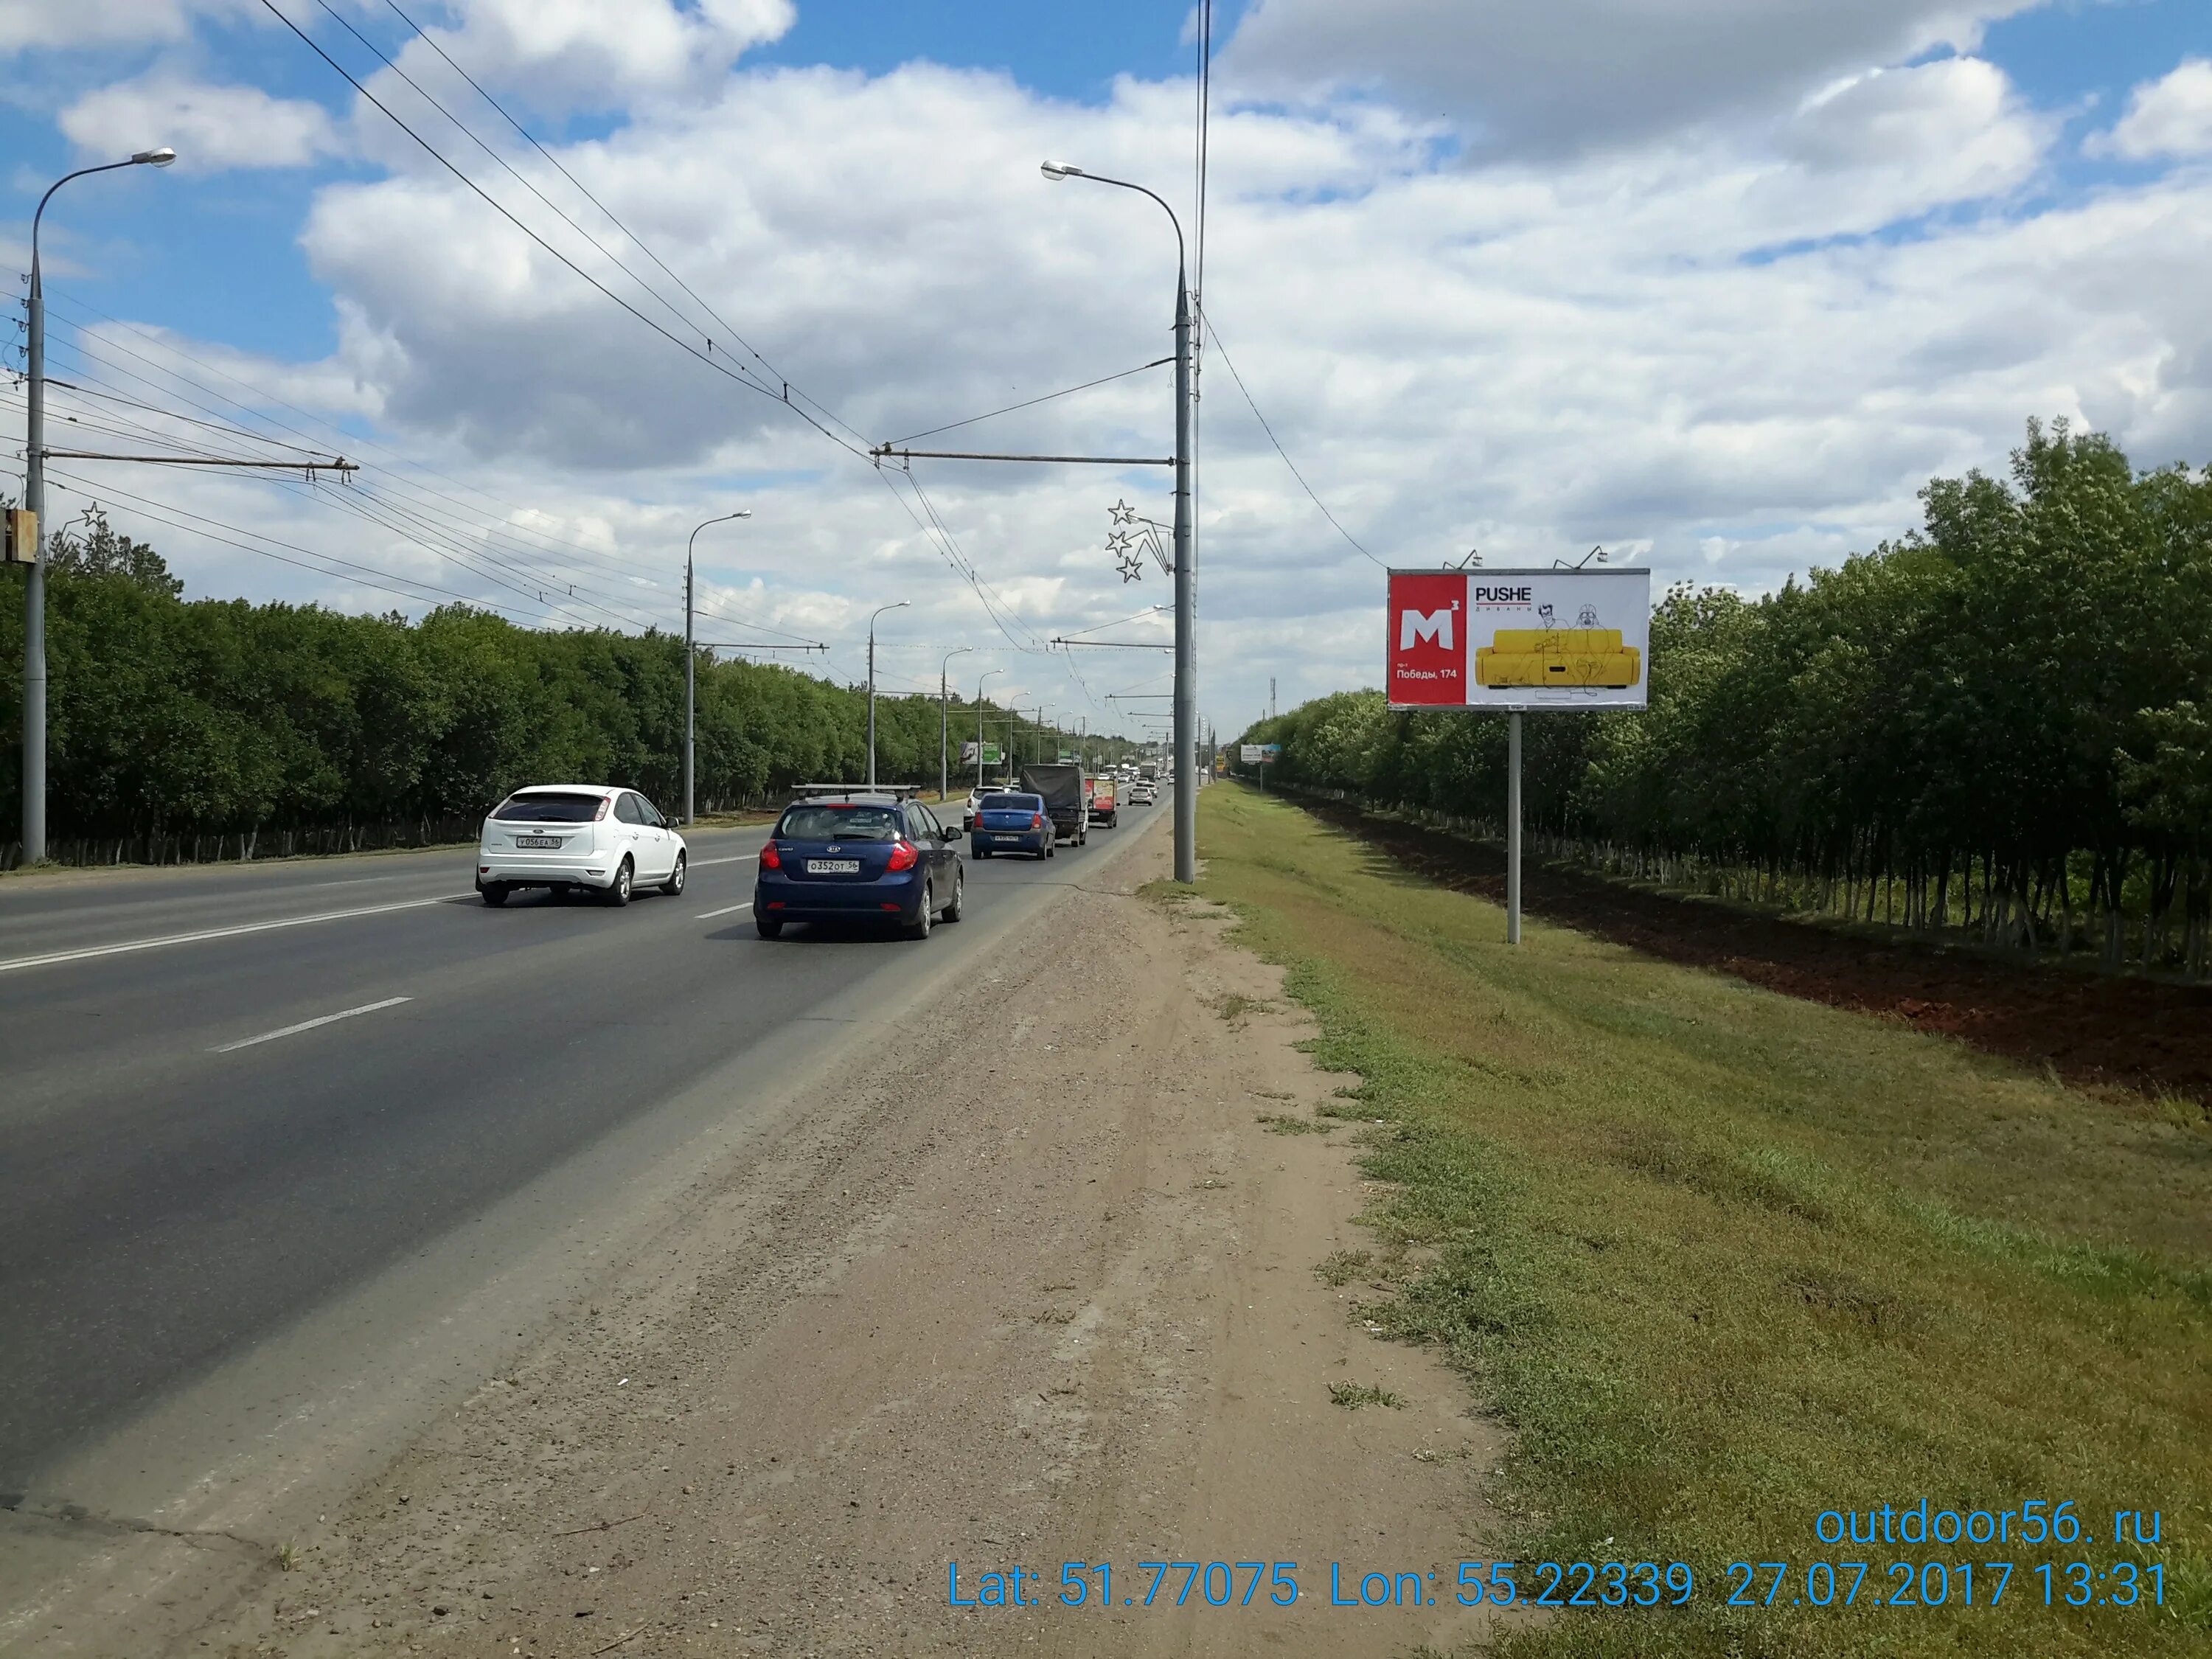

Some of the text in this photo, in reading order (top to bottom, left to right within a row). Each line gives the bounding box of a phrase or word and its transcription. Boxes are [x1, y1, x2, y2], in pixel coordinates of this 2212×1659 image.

[1475, 587, 1531, 601] PUSHE
[1397, 669, 1457, 679] Победы, 174
